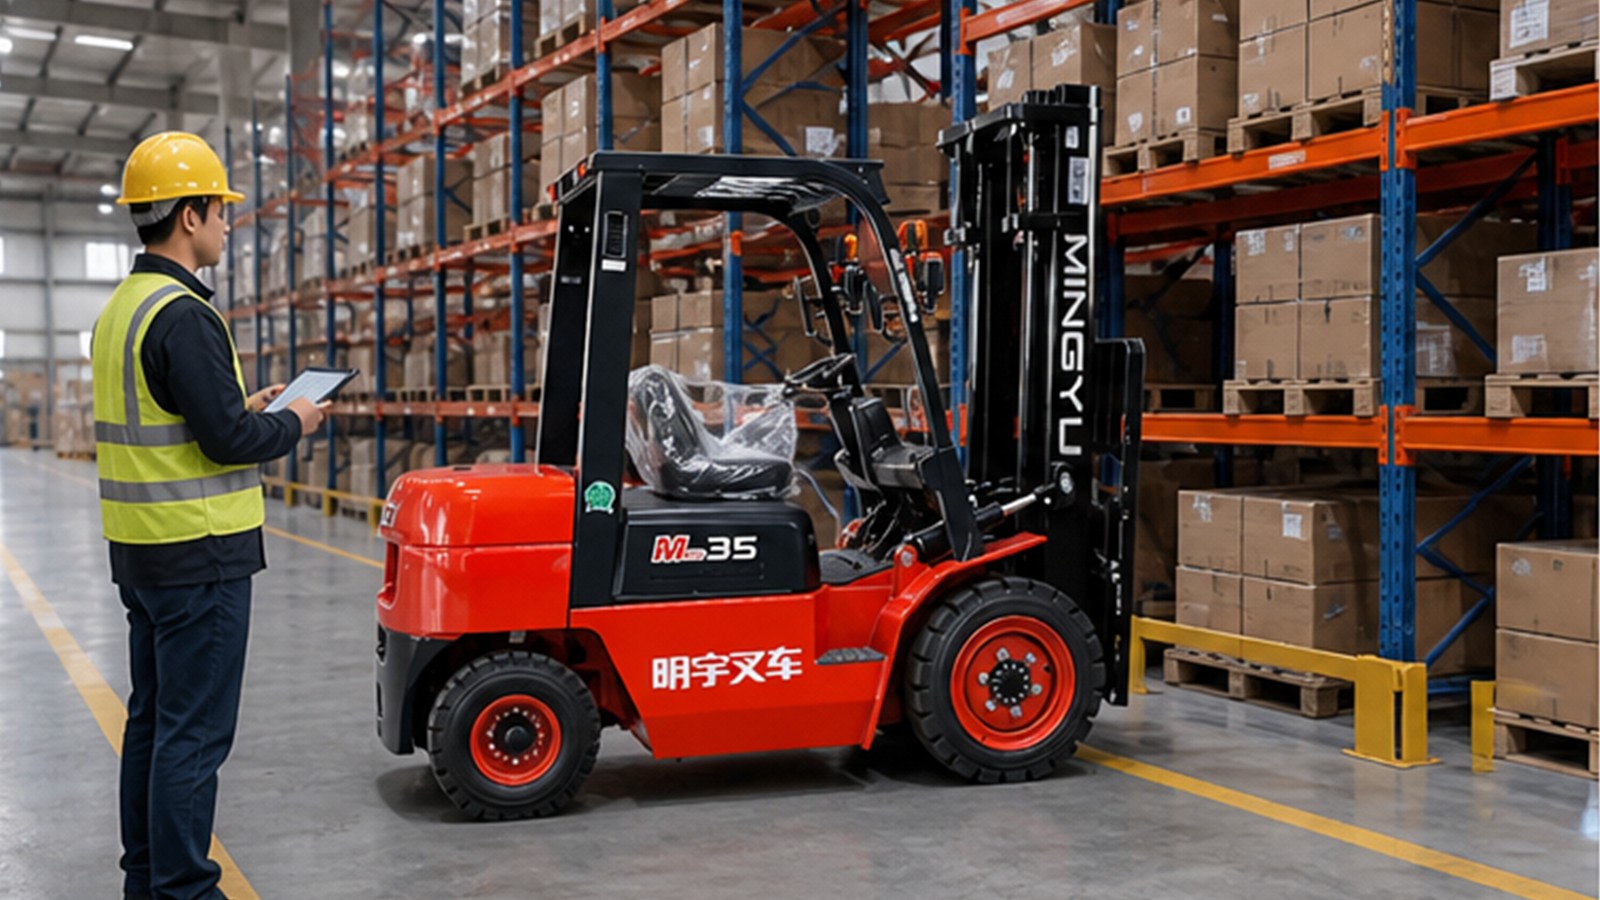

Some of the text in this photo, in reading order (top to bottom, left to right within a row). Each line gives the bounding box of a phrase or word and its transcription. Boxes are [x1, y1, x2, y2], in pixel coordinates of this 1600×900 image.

[1059, 234, 1087, 456] MINGYU
[653, 646, 802, 690] 明宇叉车
